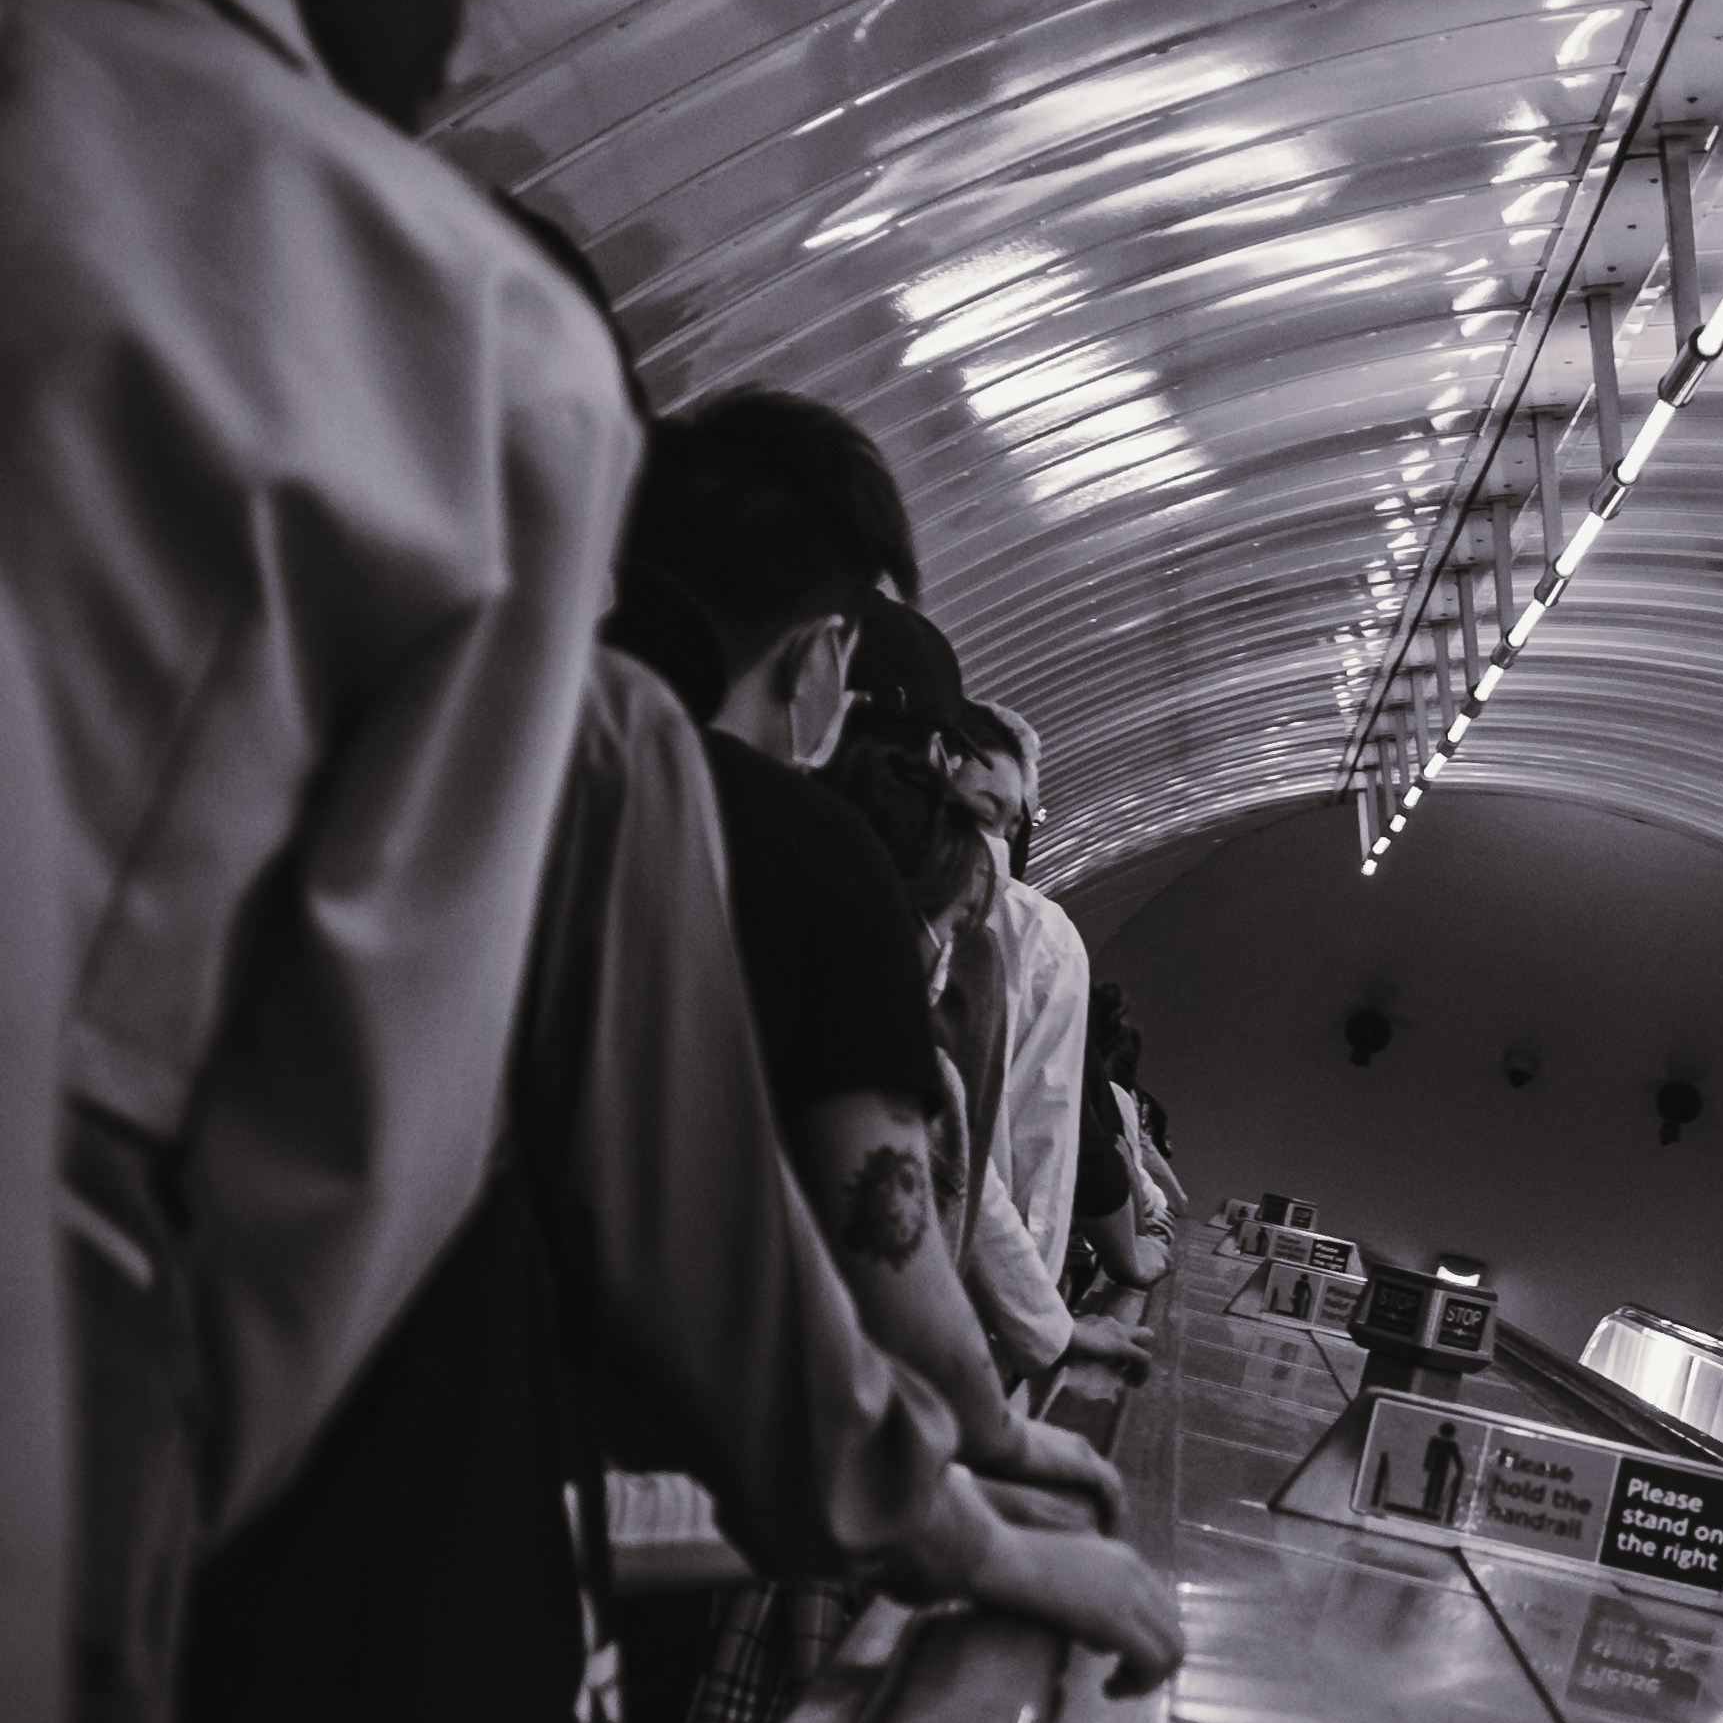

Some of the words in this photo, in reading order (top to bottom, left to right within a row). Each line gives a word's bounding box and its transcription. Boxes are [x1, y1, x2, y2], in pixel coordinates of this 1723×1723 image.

[1445, 1304, 1483, 1327] STOP
[1491, 1474, 1546, 1505] hold
[1552, 1489, 1593, 1515] the
[1627, 1477, 1704, 1514] Please
[1621, 1508, 1689, 1537] stand
[1617, 1531, 1658, 1558] the
[1662, 1542, 1719, 1573] right
